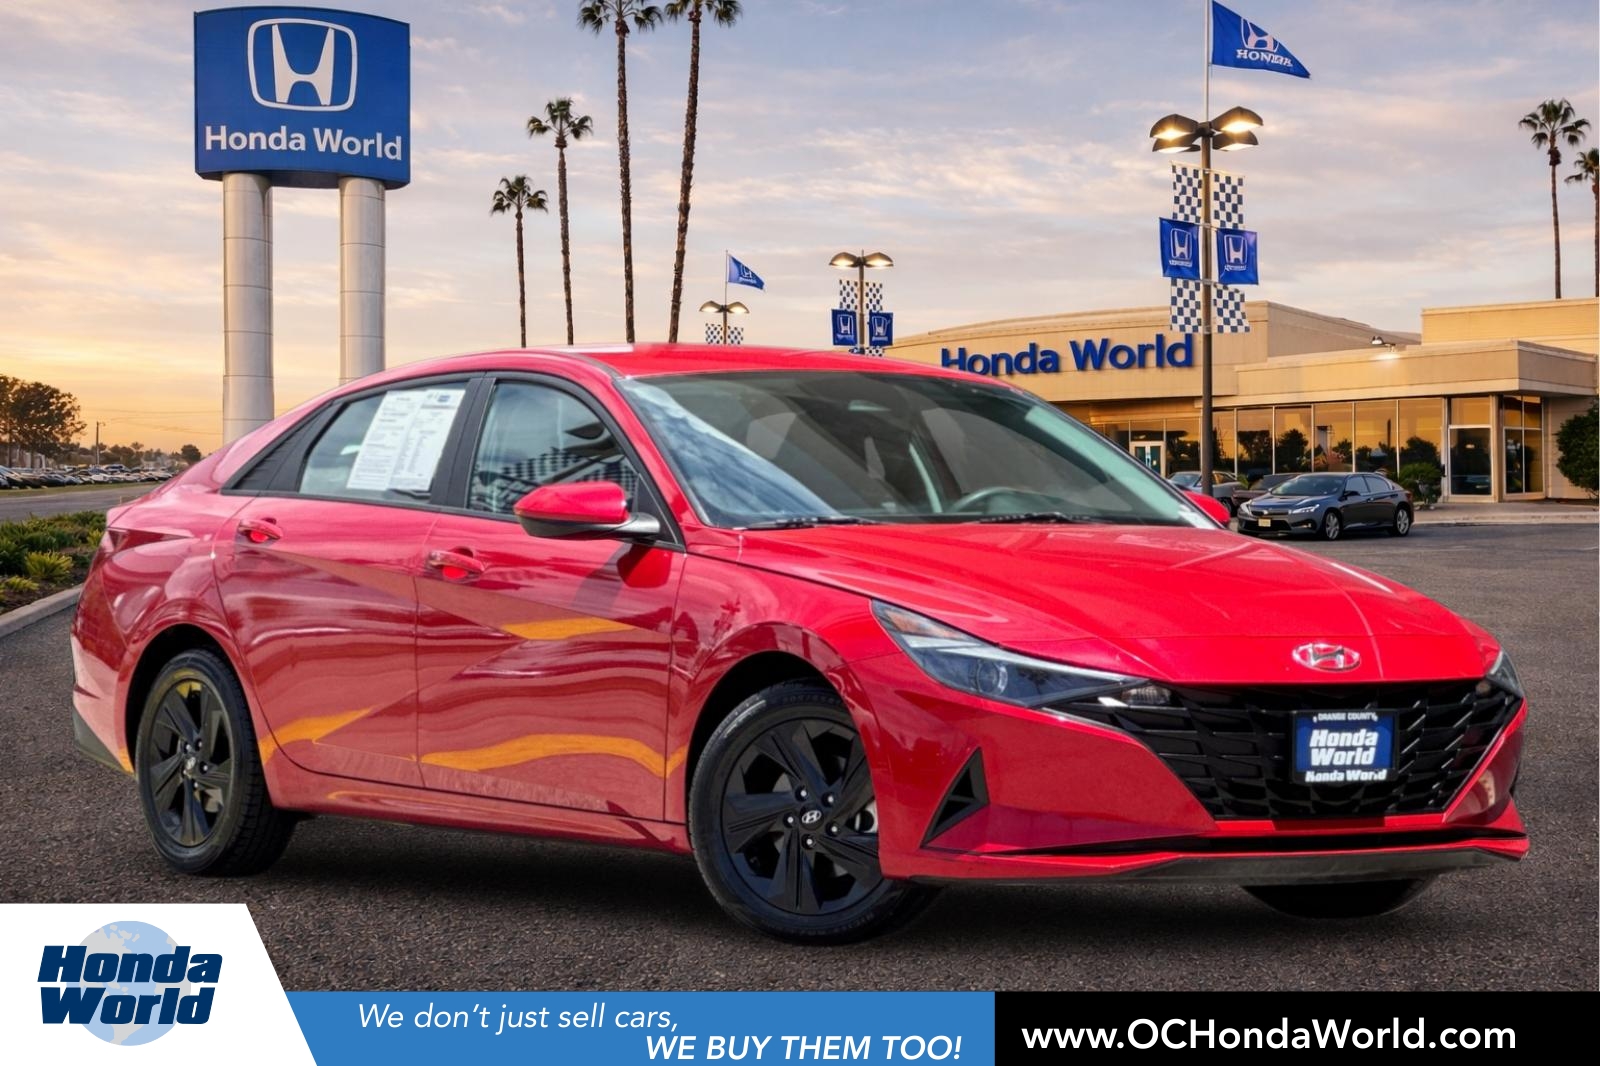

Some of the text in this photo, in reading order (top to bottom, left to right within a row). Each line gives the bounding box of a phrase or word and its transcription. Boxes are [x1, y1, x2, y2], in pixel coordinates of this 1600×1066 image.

[205, 125, 402, 161] Honda World
[941, 333, 1194, 377] Honda World
[1309, 728, 1379, 748] Honda
[1311, 747, 1376, 766] World
